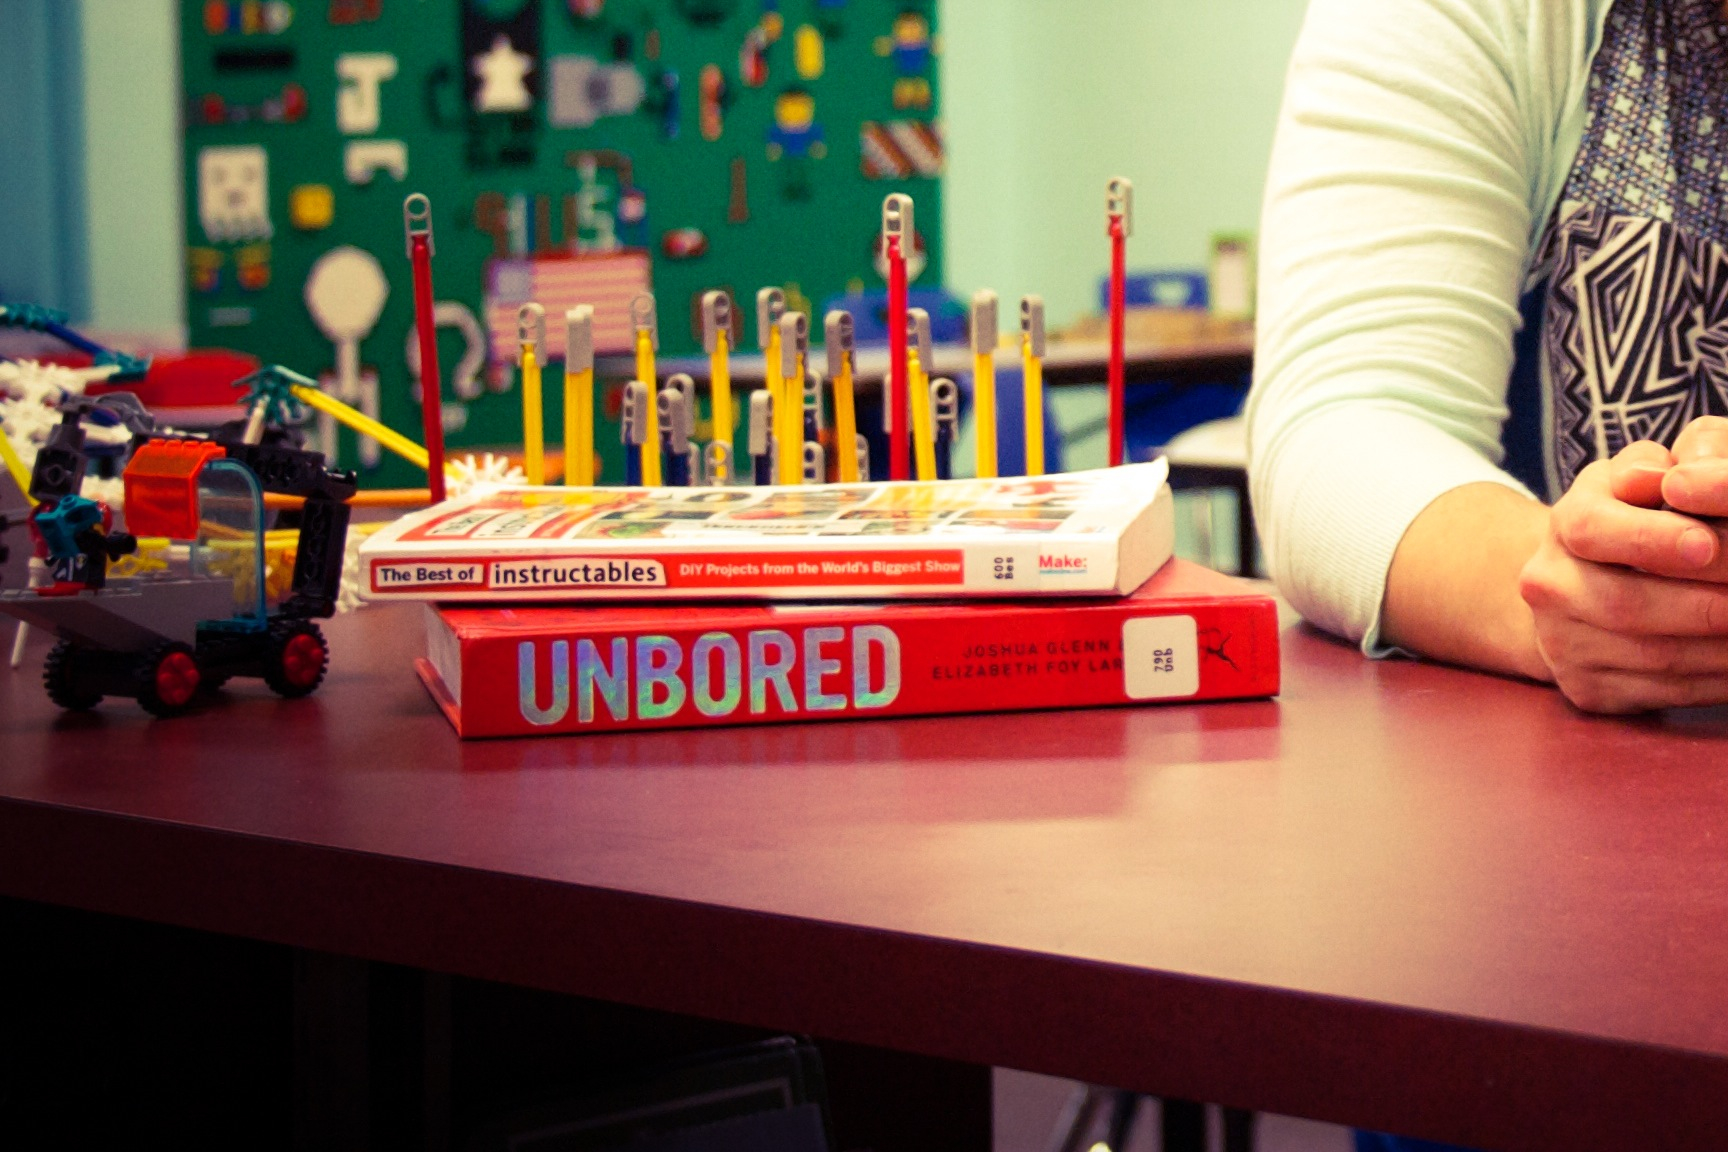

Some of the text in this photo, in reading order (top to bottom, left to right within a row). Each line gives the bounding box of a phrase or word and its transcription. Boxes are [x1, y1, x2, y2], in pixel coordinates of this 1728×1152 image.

[679, 559, 961, 577] DIY Projects from the World's Biggest Show
[993, 557, 1004, 579] 600
[1039, 554, 1087, 568] Make:
[381, 561, 658, 584] The Best of instructables
[962, 639, 1111, 659] JOSHUA GLENN
[932, 657, 1124, 680] ELIZABETH FOY LAR
[1153, 649, 1164, 672] 790
[518, 624, 902, 726] UNBORED
